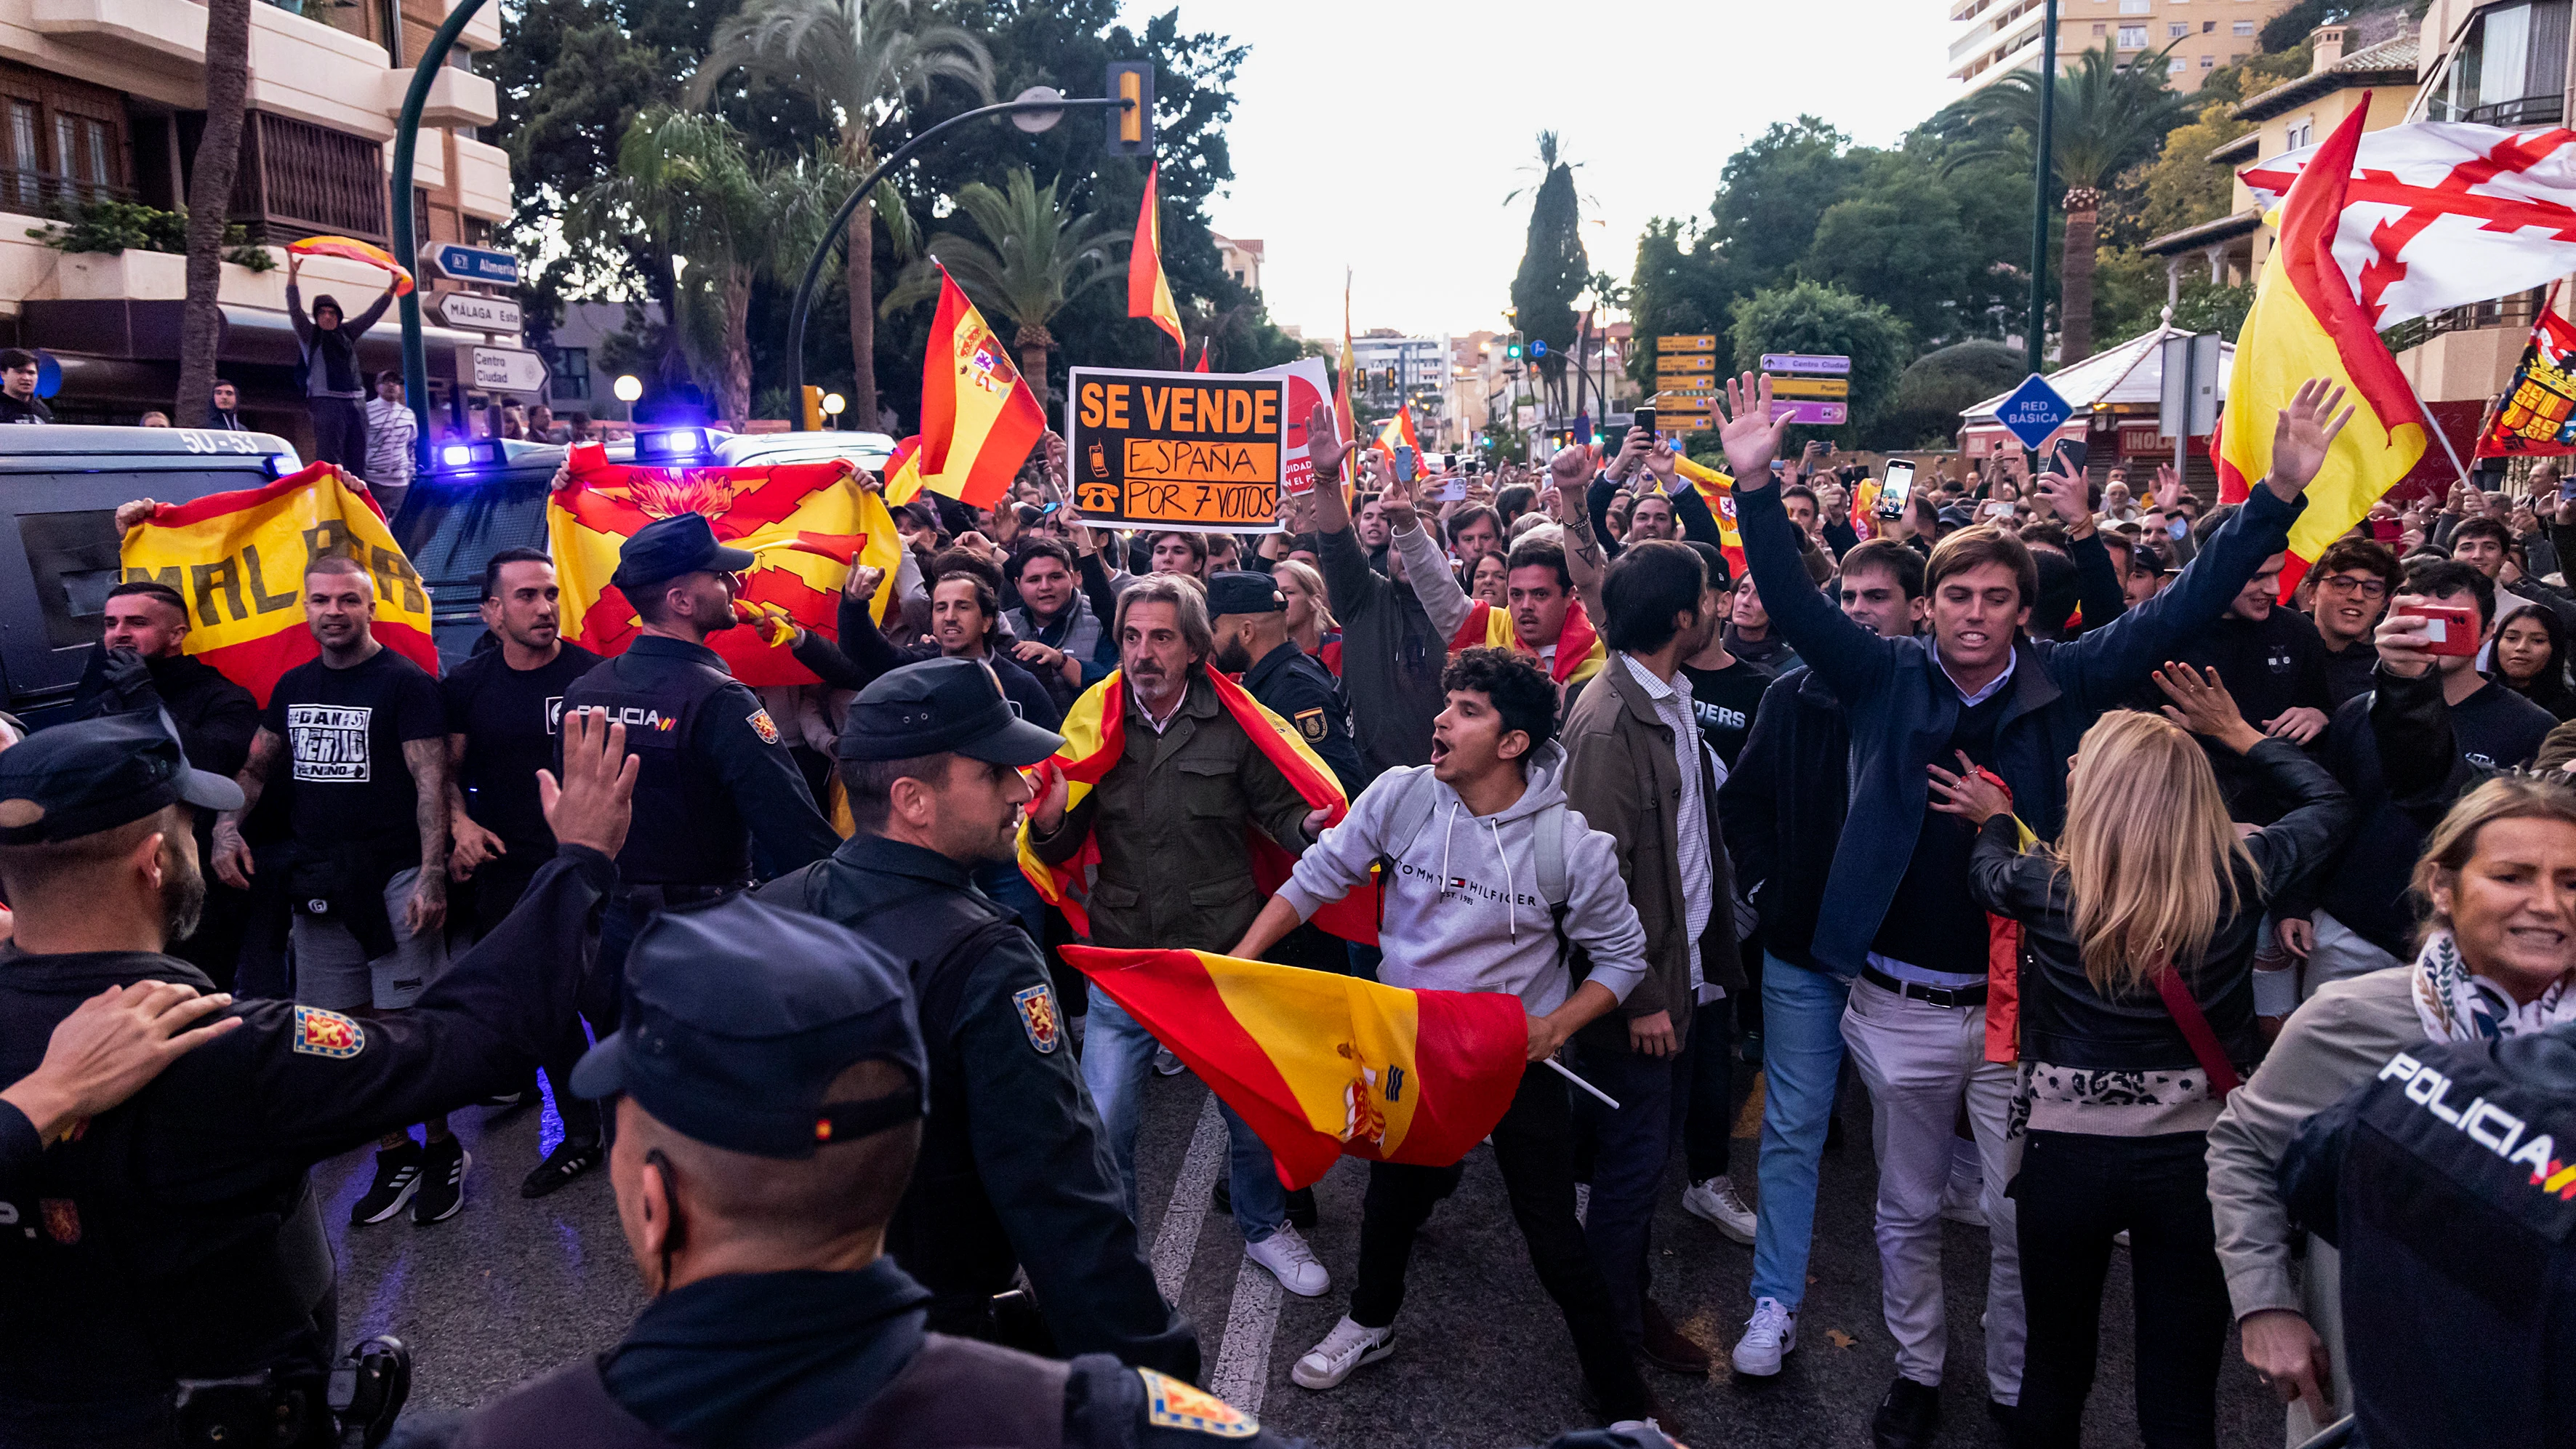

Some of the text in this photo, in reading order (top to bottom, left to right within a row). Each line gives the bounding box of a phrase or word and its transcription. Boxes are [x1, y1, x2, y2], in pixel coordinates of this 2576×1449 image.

[451, 302, 518, 323] MÁLAGA Este
[475, 353, 505, 366] Centro
[1793, 360, 1818, 369] Centro
[476, 370, 507, 383] Ciudad
[1080, 382, 1277, 434] SE VENDE
[2021, 401, 2048, 411] RED
[1129, 440, 1257, 475] ESPAÑA
[1294, 476, 1304, 486] EL
[1128, 481, 1275, 518] POR 7 VOTOS
[577, 705, 659, 726] PLICIA
[1695, 700, 1746, 729] DERS
[1397, 860, 1444, 886] TOMMY
[1460, 894, 1473, 906] 1985
[1469, 881, 1537, 907] HILFIGER
[2378, 1051, 2554, 1179] POLICIA
